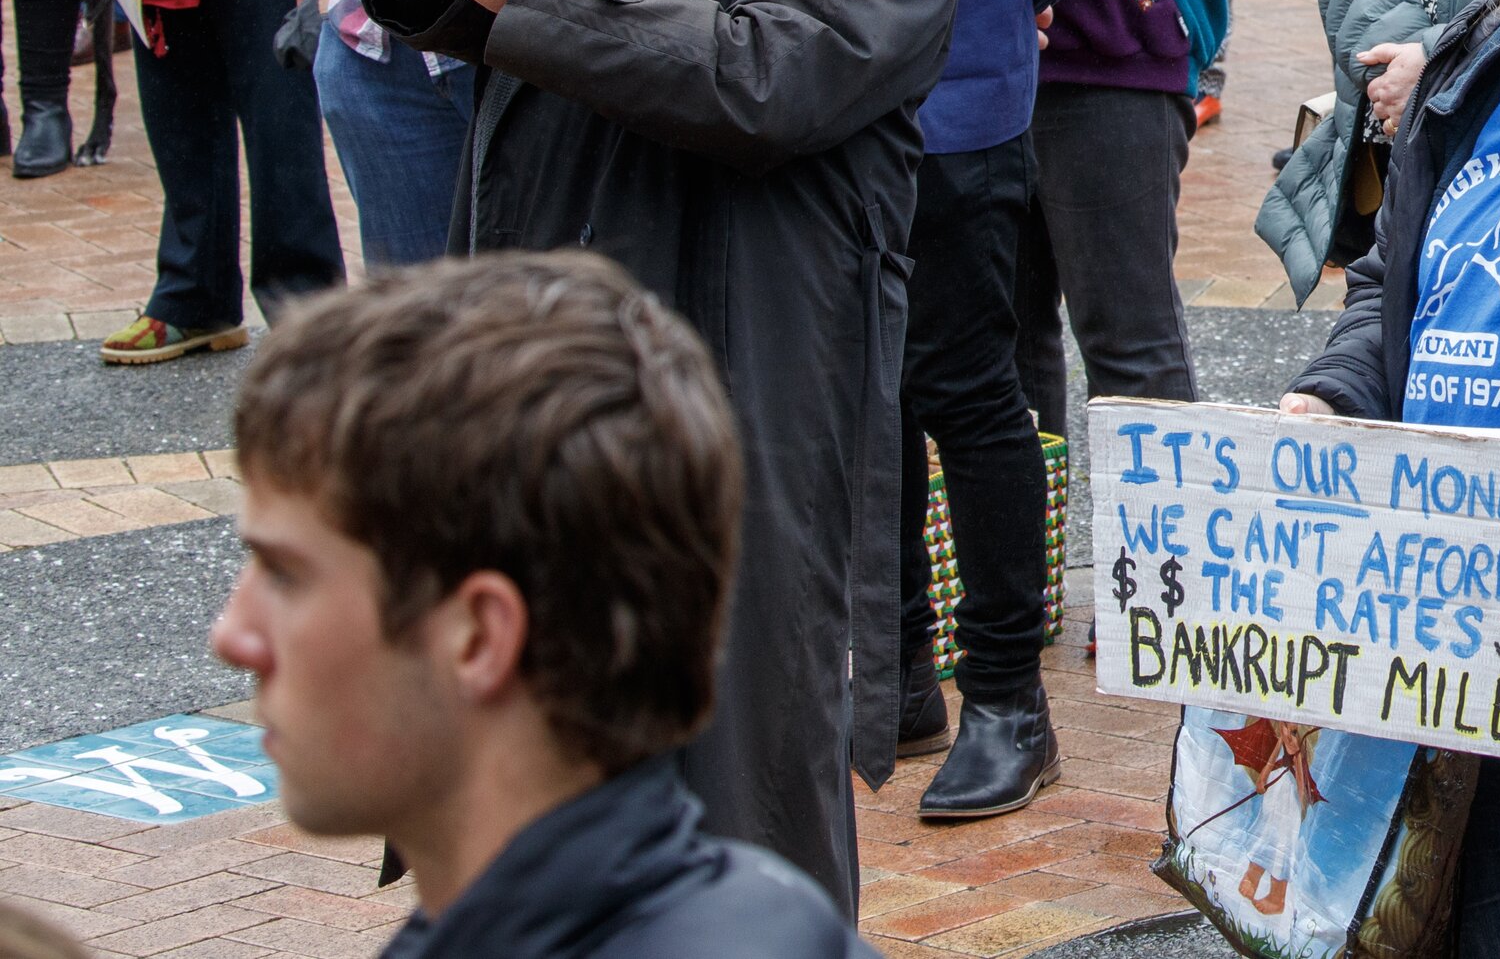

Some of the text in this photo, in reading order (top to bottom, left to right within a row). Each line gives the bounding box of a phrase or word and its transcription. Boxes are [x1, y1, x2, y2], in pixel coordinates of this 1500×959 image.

[1430, 374, 1459, 404] OF
[1117, 422, 1240, 494] IT'S
[1272, 436, 1361, 503] OUR
[1117, 503, 1190, 557] WE
[1205, 507, 1340, 576] CAN'T
[1201, 561, 1284, 622] THE
[1316, 576, 1484, 659] RATES
[1128, 606, 1361, 716] BANKRUPT
